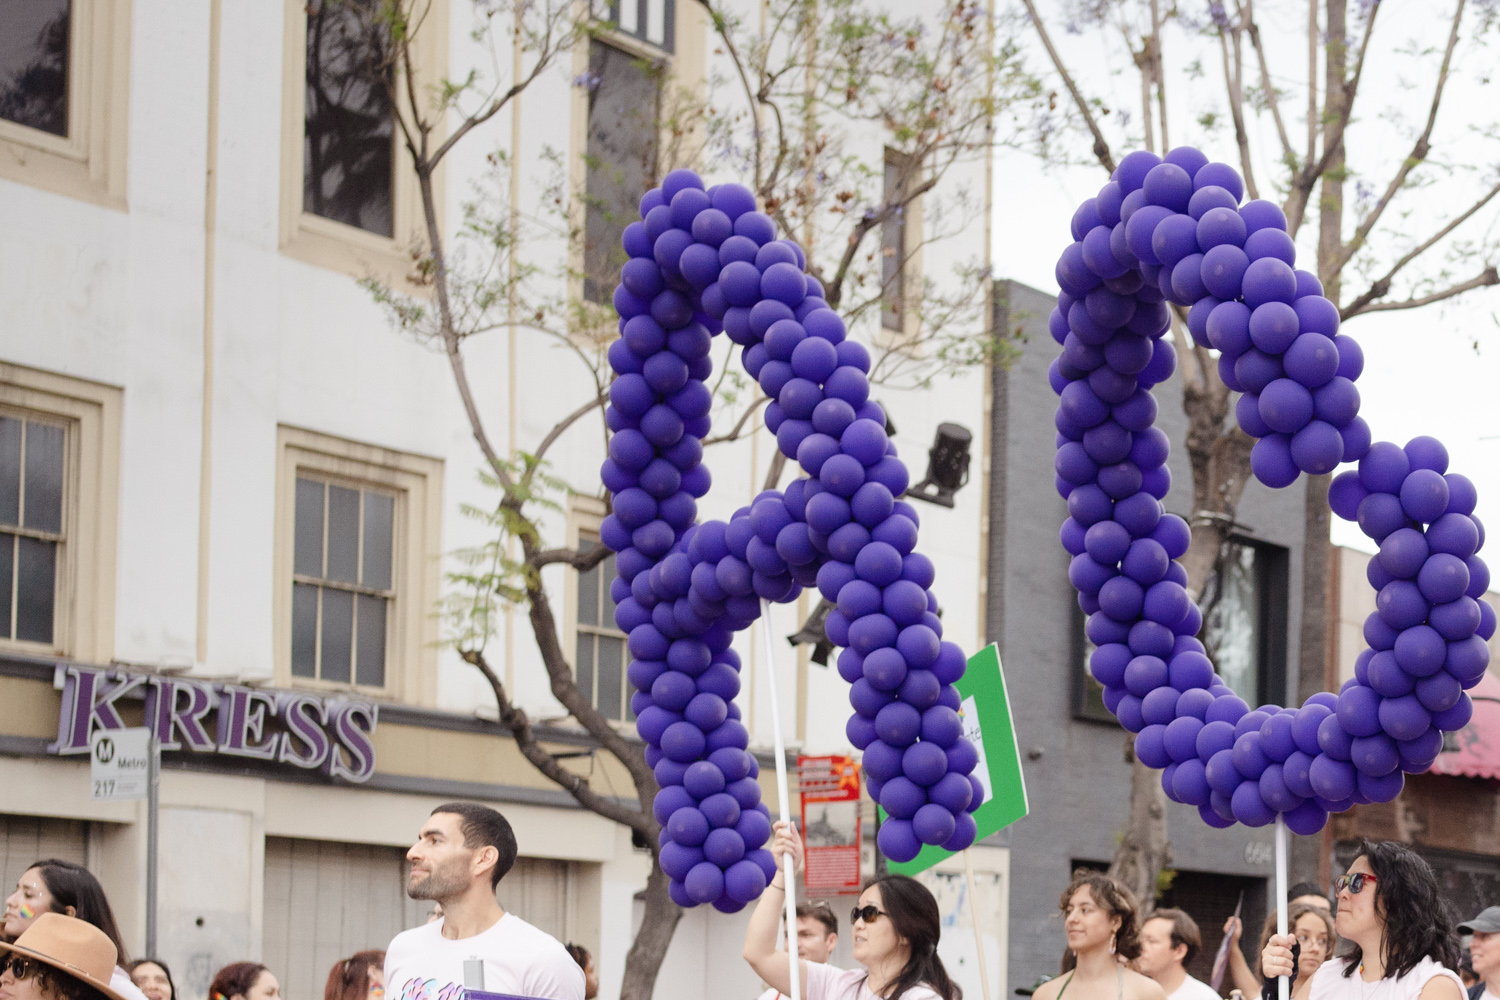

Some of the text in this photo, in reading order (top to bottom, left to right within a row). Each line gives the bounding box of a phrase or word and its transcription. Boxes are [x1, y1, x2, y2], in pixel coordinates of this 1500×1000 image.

[57, 666, 379, 783] KRESS
[117, 757, 147, 770] Metro
[95, 779, 116, 797] 217
